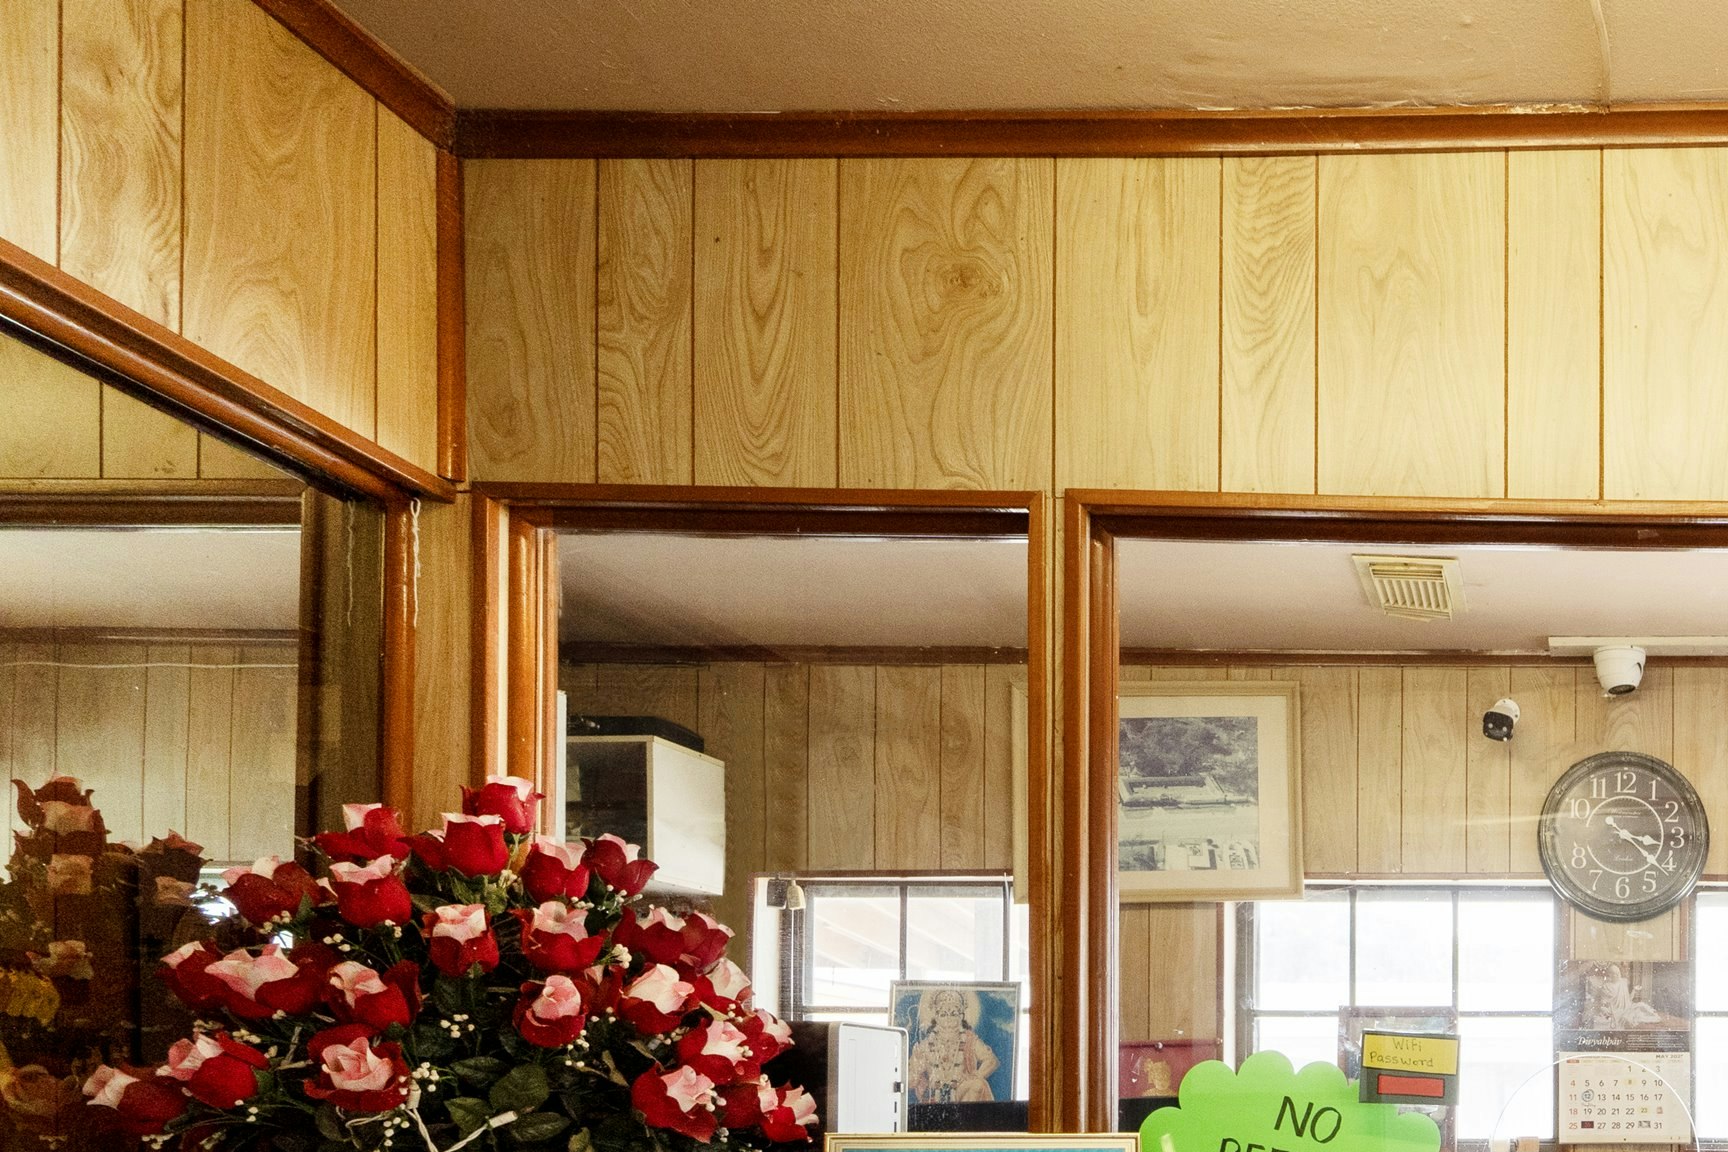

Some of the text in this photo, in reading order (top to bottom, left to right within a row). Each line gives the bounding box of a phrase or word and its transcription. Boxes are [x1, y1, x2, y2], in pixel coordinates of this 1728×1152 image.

[1591, 778, 1608, 799] 11
[1614, 772, 1637, 793] 12
[1649, 780, 1658, 801] 1
[1569, 799, 1590, 819] 10
[1664, 801, 1679, 823] 2
[1670, 827, 1685, 848] 3
[1571, 847, 1587, 869] 8
[1661, 851, 1677, 872] 4
[1589, 870, 1603, 891] 7
[1615, 877, 1630, 898] 6
[1642, 872, 1657, 893] 5
[1569, 1093, 1577, 1101] 11
[1598, 1093, 1606, 1101] 13
[1612, 1093, 1621, 1101] 14
[1626, 1093, 1635, 1101] 15
[1640, 1093, 1649, 1101] 16
[1654, 1093, 1663, 1101] 17
[1274, 1096, 1343, 1143] NO
[1569, 1122, 1578, 1130] 25
[1597, 1122, 1607, 1130] 27
[1612, 1122, 1621, 1130] 28
[1626, 1122, 1635, 1130] 29
[1654, 1122, 1663, 1130] 31
